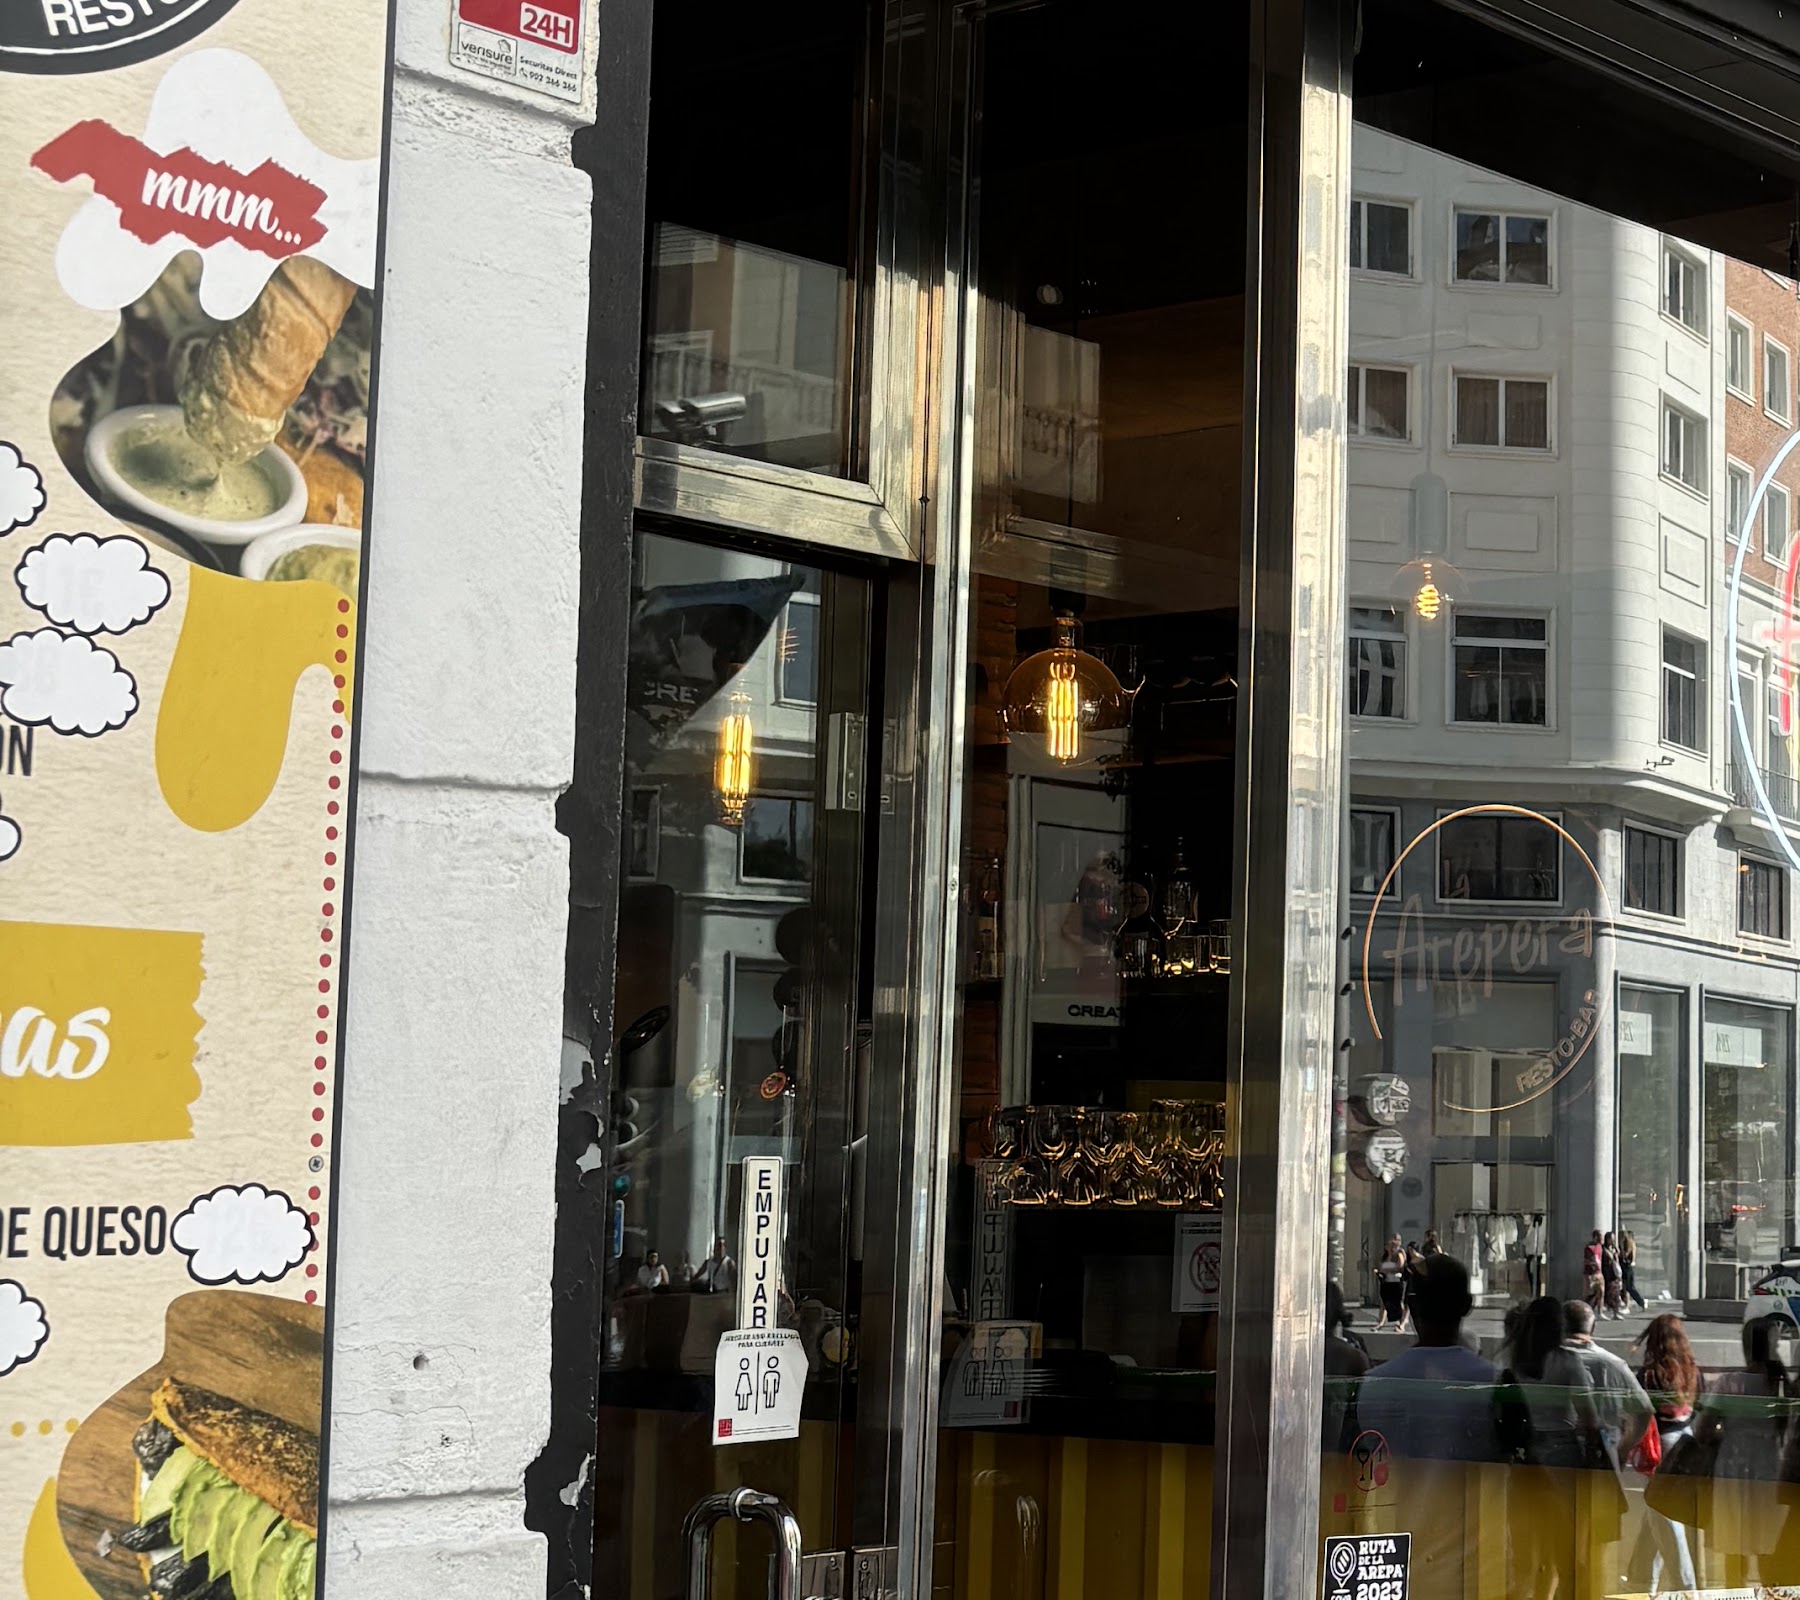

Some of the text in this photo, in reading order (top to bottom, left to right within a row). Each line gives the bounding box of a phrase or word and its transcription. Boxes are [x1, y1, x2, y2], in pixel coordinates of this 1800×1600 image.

[523, 7, 571, 43] 24H
[461, 41, 513, 64] verisure
[520, 56, 553, 73] Securitas
[555, 66, 578, 80] Direct
[43, 1206, 167, 1261] QUESO
[752, 1168, 773, 1328] EMPUJAR
[1359, 1539, 1396, 1555] RUTA
[1359, 1555, 1384, 1566] DE LA
